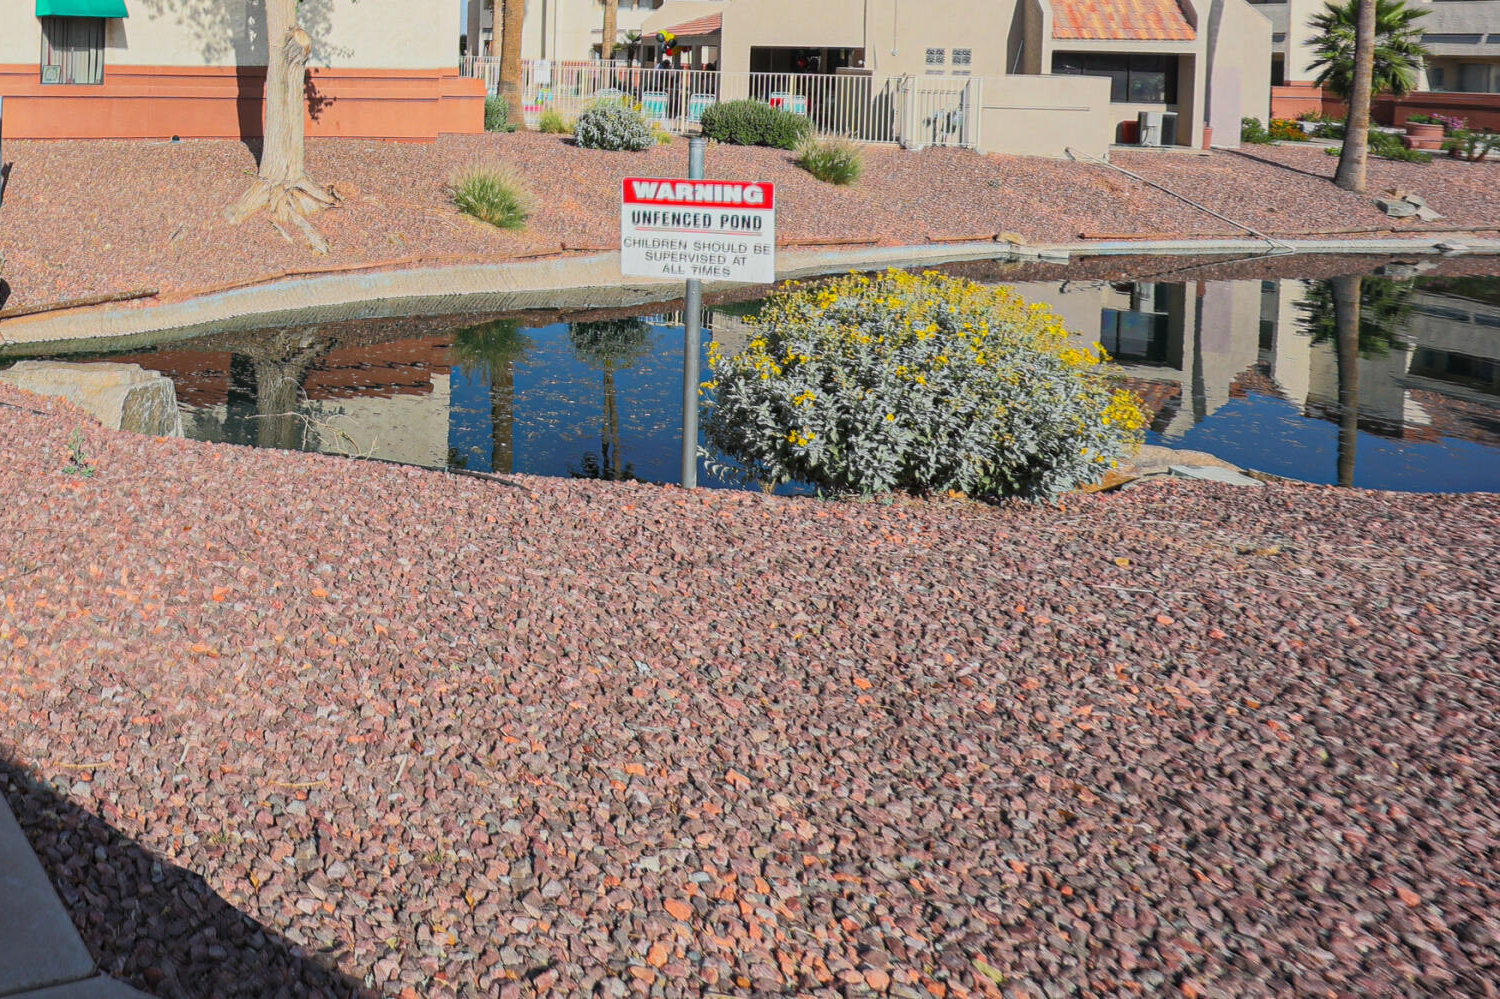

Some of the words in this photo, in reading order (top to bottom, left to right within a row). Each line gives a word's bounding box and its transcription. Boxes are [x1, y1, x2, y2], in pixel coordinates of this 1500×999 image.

[632, 181, 764, 204] WARNING
[631, 210, 712, 229] UNFENCED
[720, 214, 763, 231] POND
[623, 237, 687, 250] CHILDREN
[693, 241, 748, 254] SHOULD
[753, 244, 772, 256] BE
[644, 252, 726, 265] SUPERVISED
[732, 256, 748, 267] AT
[662, 264, 685, 274] ALL
[691, 265, 731, 277] TIMES
